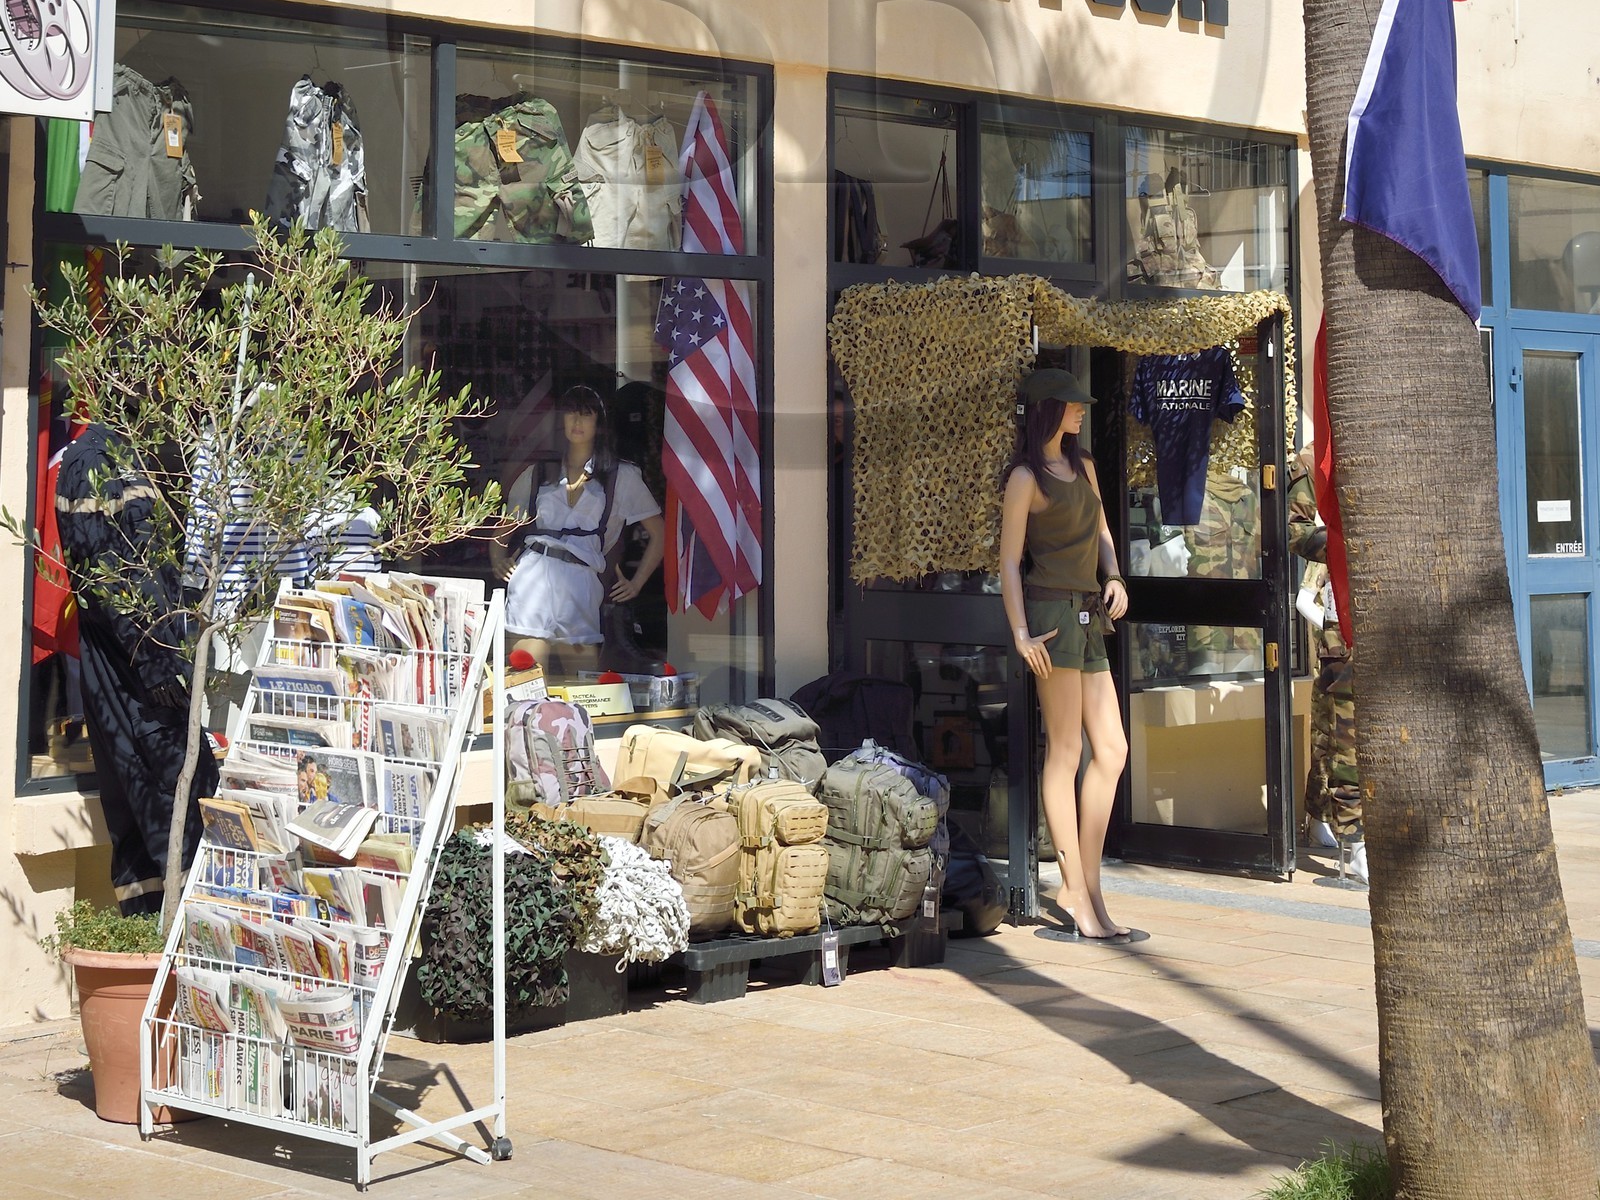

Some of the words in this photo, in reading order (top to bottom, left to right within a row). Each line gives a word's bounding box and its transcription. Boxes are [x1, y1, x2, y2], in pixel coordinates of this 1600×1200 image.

[1156, 379, 1212, 398] MARINE
[1156, 402, 1211, 411] NATIONALE
[1555, 540, 1583, 553] ENTRÉE
[1158, 625, 1186, 634] EXPLORER
[1175, 633, 1186, 641] KIT
[269, 681, 285, 689] LE
[286, 682, 325, 693] FIGARO
